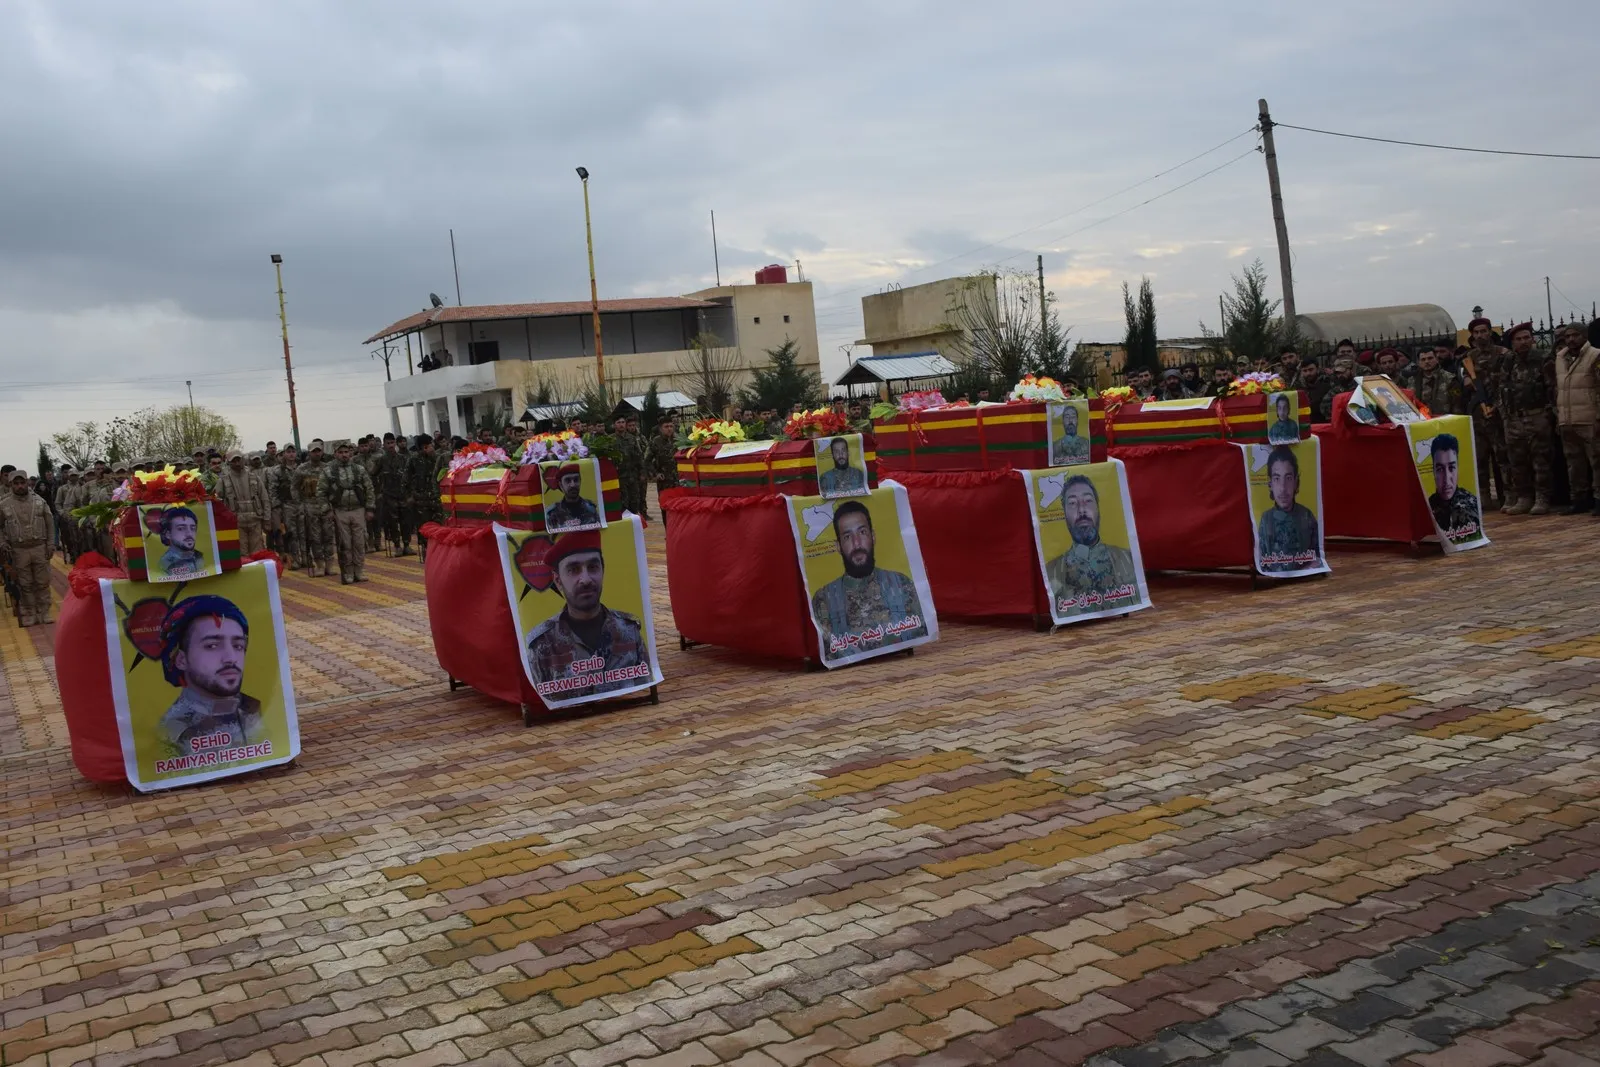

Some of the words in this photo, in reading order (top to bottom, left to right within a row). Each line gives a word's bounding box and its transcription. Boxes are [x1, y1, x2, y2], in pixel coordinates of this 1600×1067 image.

[1456, 522, 1477, 538] الشهيد
[1294, 549, 1316, 564] الشهيد
[1080, 590, 1102, 608] رضوان
[1104, 584, 1136, 602] الشهيد
[1058, 596, 1077, 611] حسين
[886, 615, 921, 636] الشهيد
[830, 632, 860, 653] جاويش
[572, 655, 605, 674] ŞEHÎD
[537, 673, 603, 694] BERXWEDAN
[605, 662, 649, 683] HESEKÊ
[191, 731, 231, 751] ŞEHÎD
[156, 752, 217, 773] RAMIYAR
[220, 741, 272, 762] HESEKÊ
